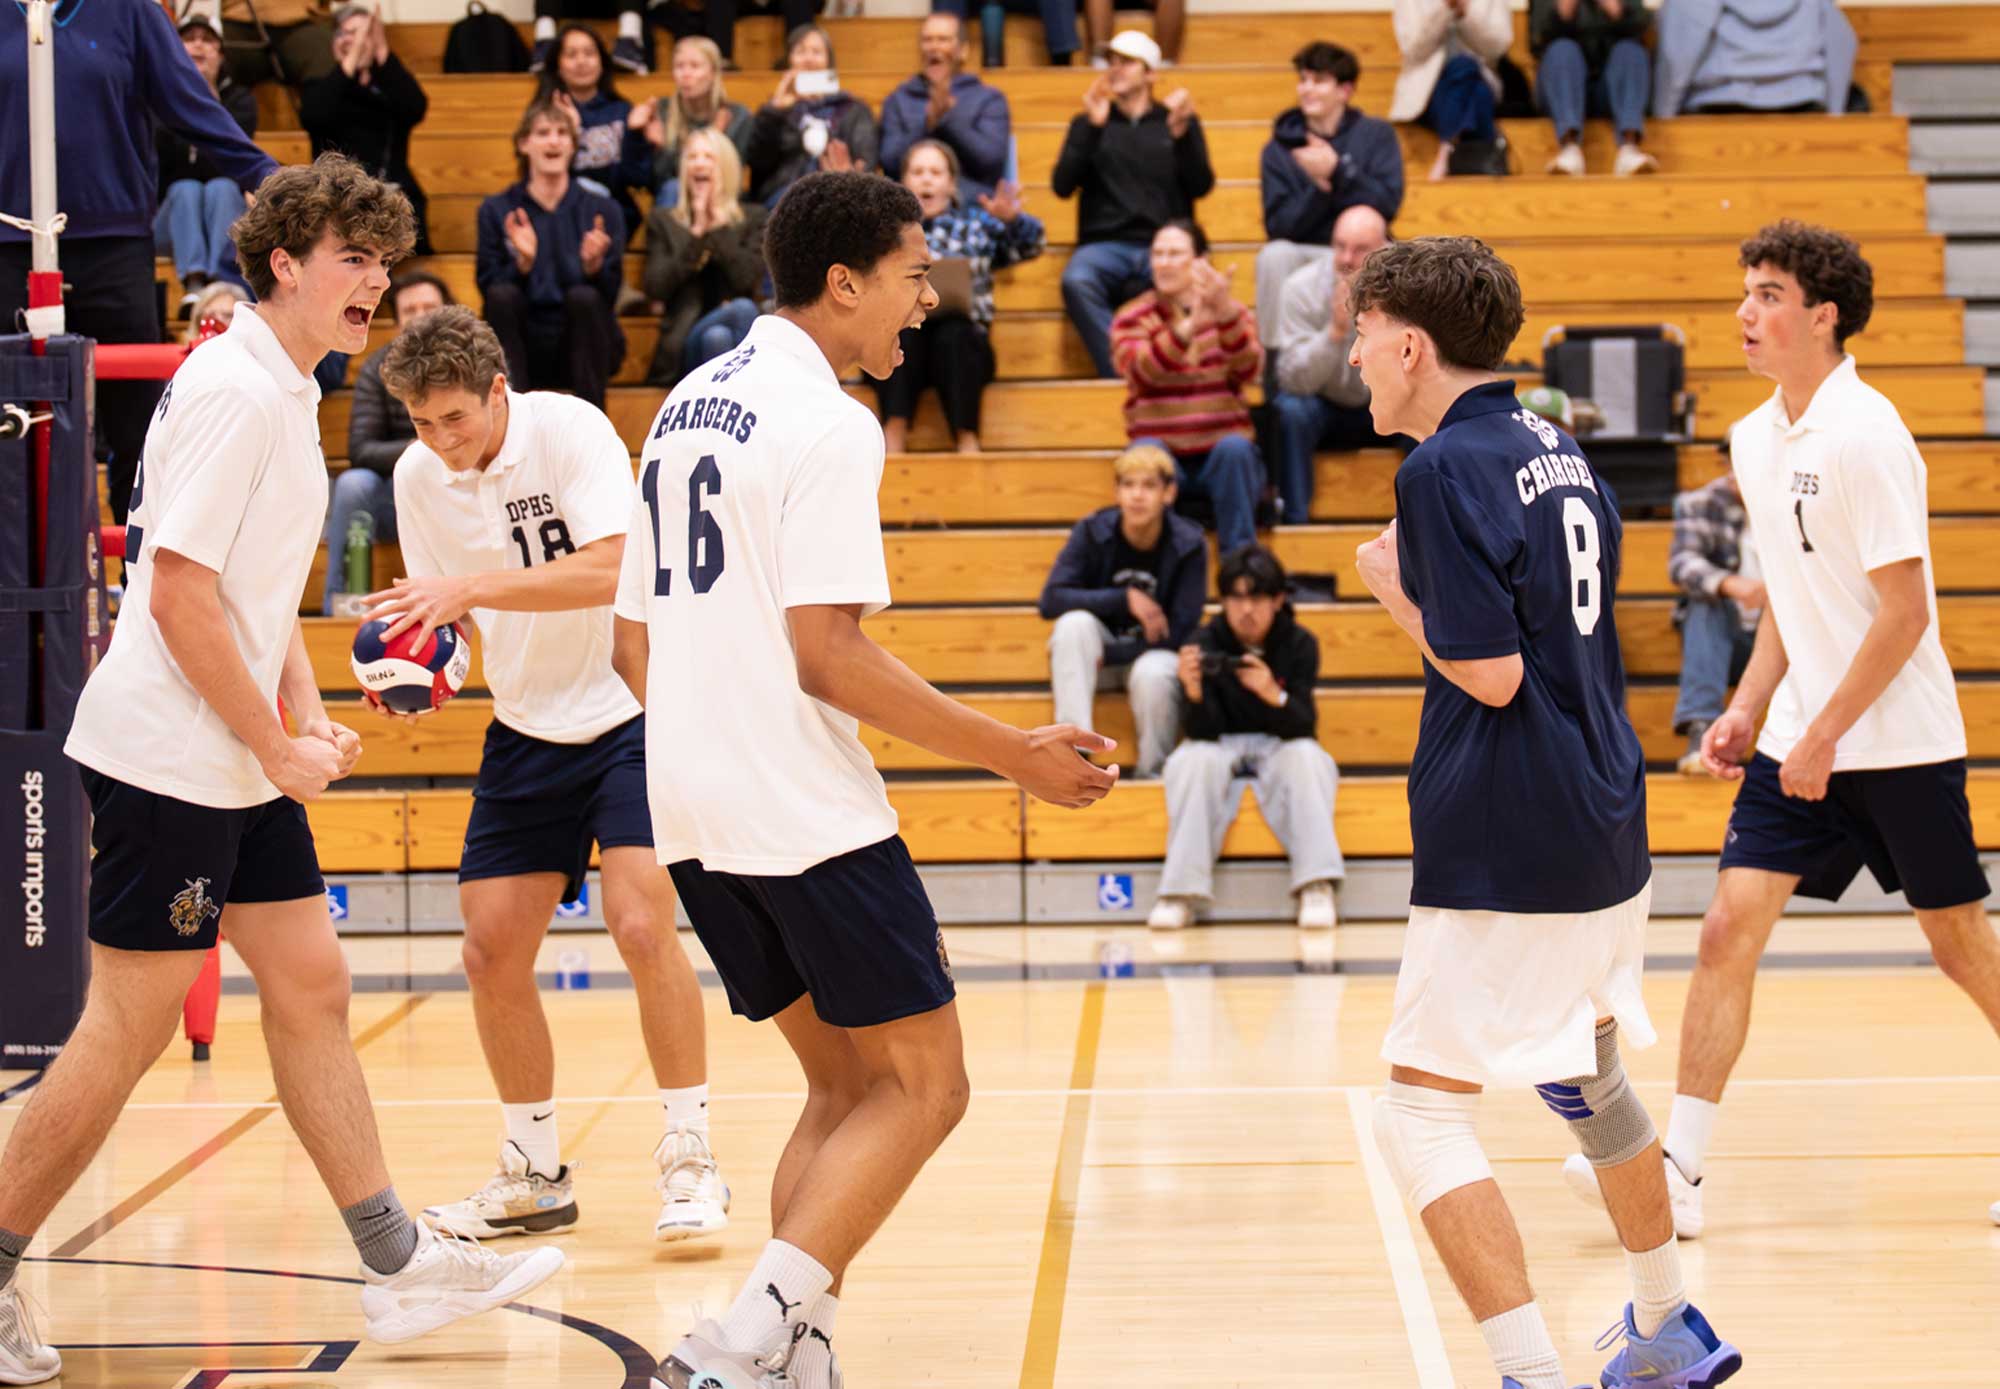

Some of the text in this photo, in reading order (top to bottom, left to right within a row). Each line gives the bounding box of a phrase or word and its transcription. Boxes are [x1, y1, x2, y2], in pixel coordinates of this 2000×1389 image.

[505, 493, 554, 523] DPHS
[512, 518, 577, 569] 18
[642, 454, 725, 597] 16
[1794, 499, 1815, 552] 1
[1563, 497, 1601, 636] 8
[21, 770, 47, 947] sports imports
